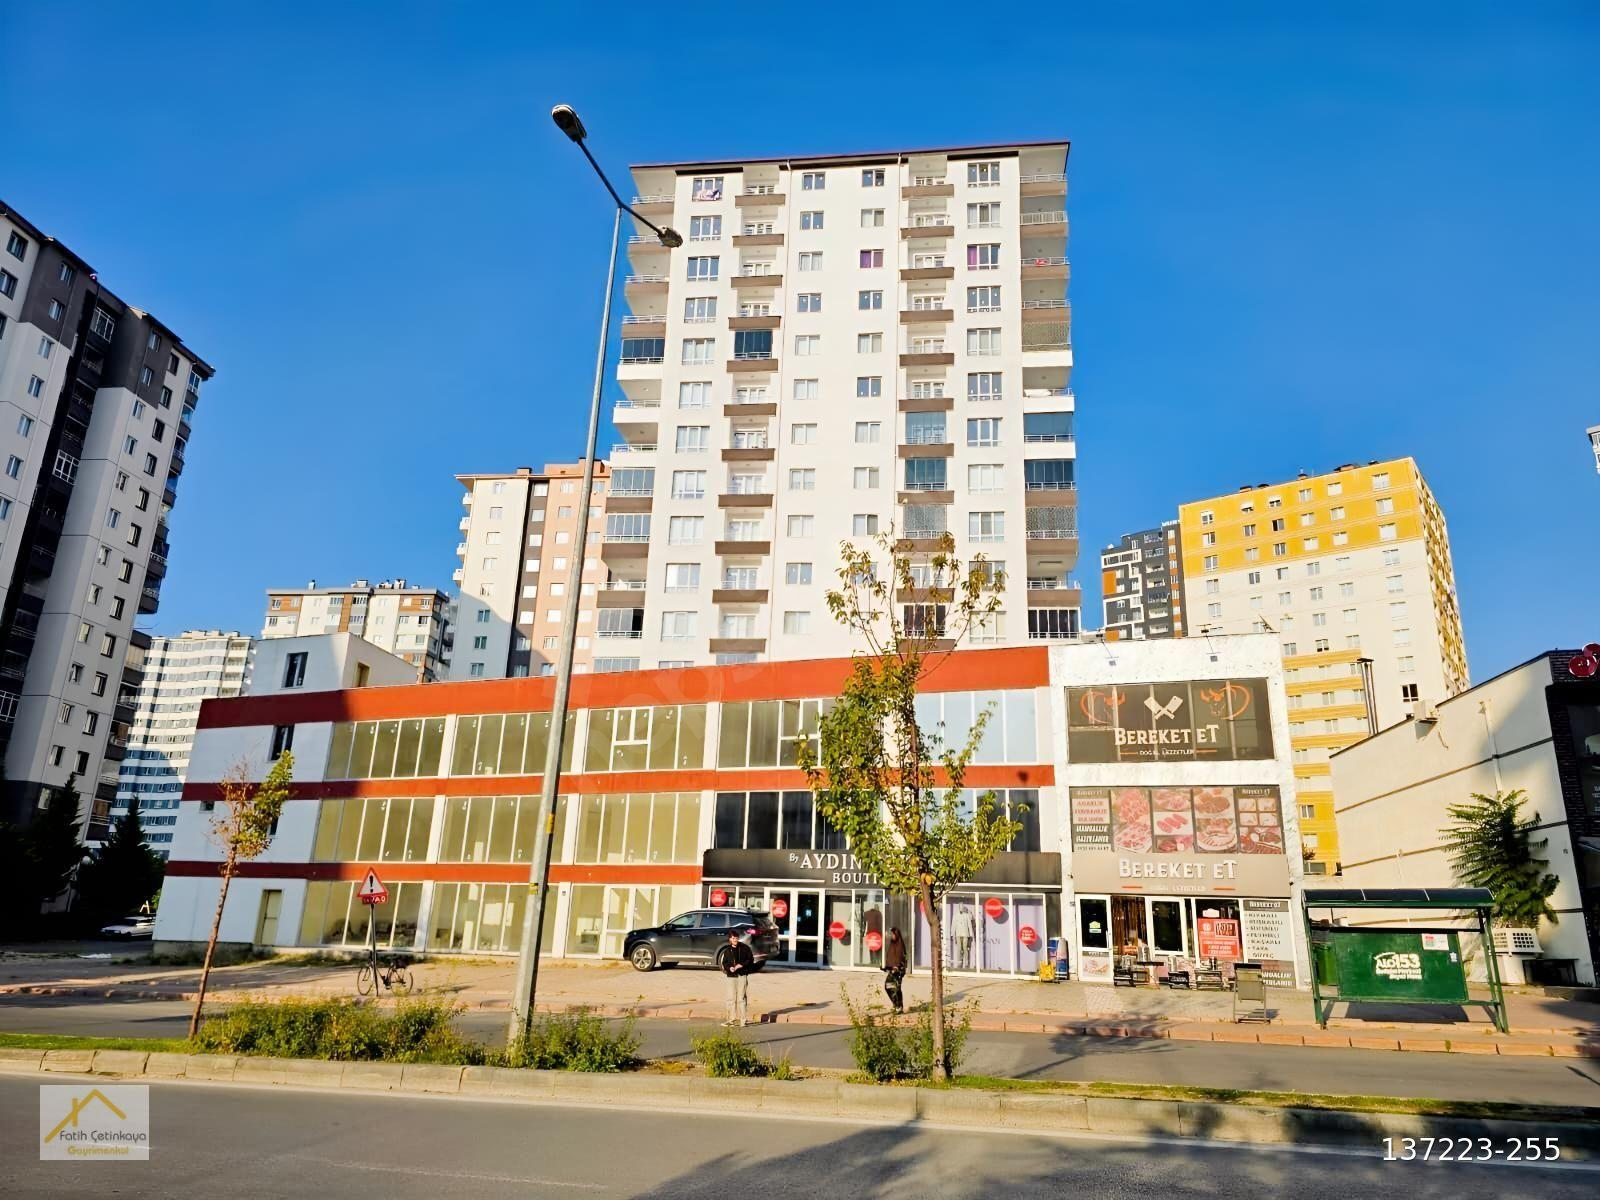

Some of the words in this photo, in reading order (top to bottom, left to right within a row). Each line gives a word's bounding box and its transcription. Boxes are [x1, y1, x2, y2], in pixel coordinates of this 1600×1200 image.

[1114, 727, 1191, 745] BEREKET
[789, 852, 799, 864] By
[1119, 858, 1206, 879] BEREKET
[1213, 859, 1238, 880] ET
[832, 872, 880, 885] BOUTI
